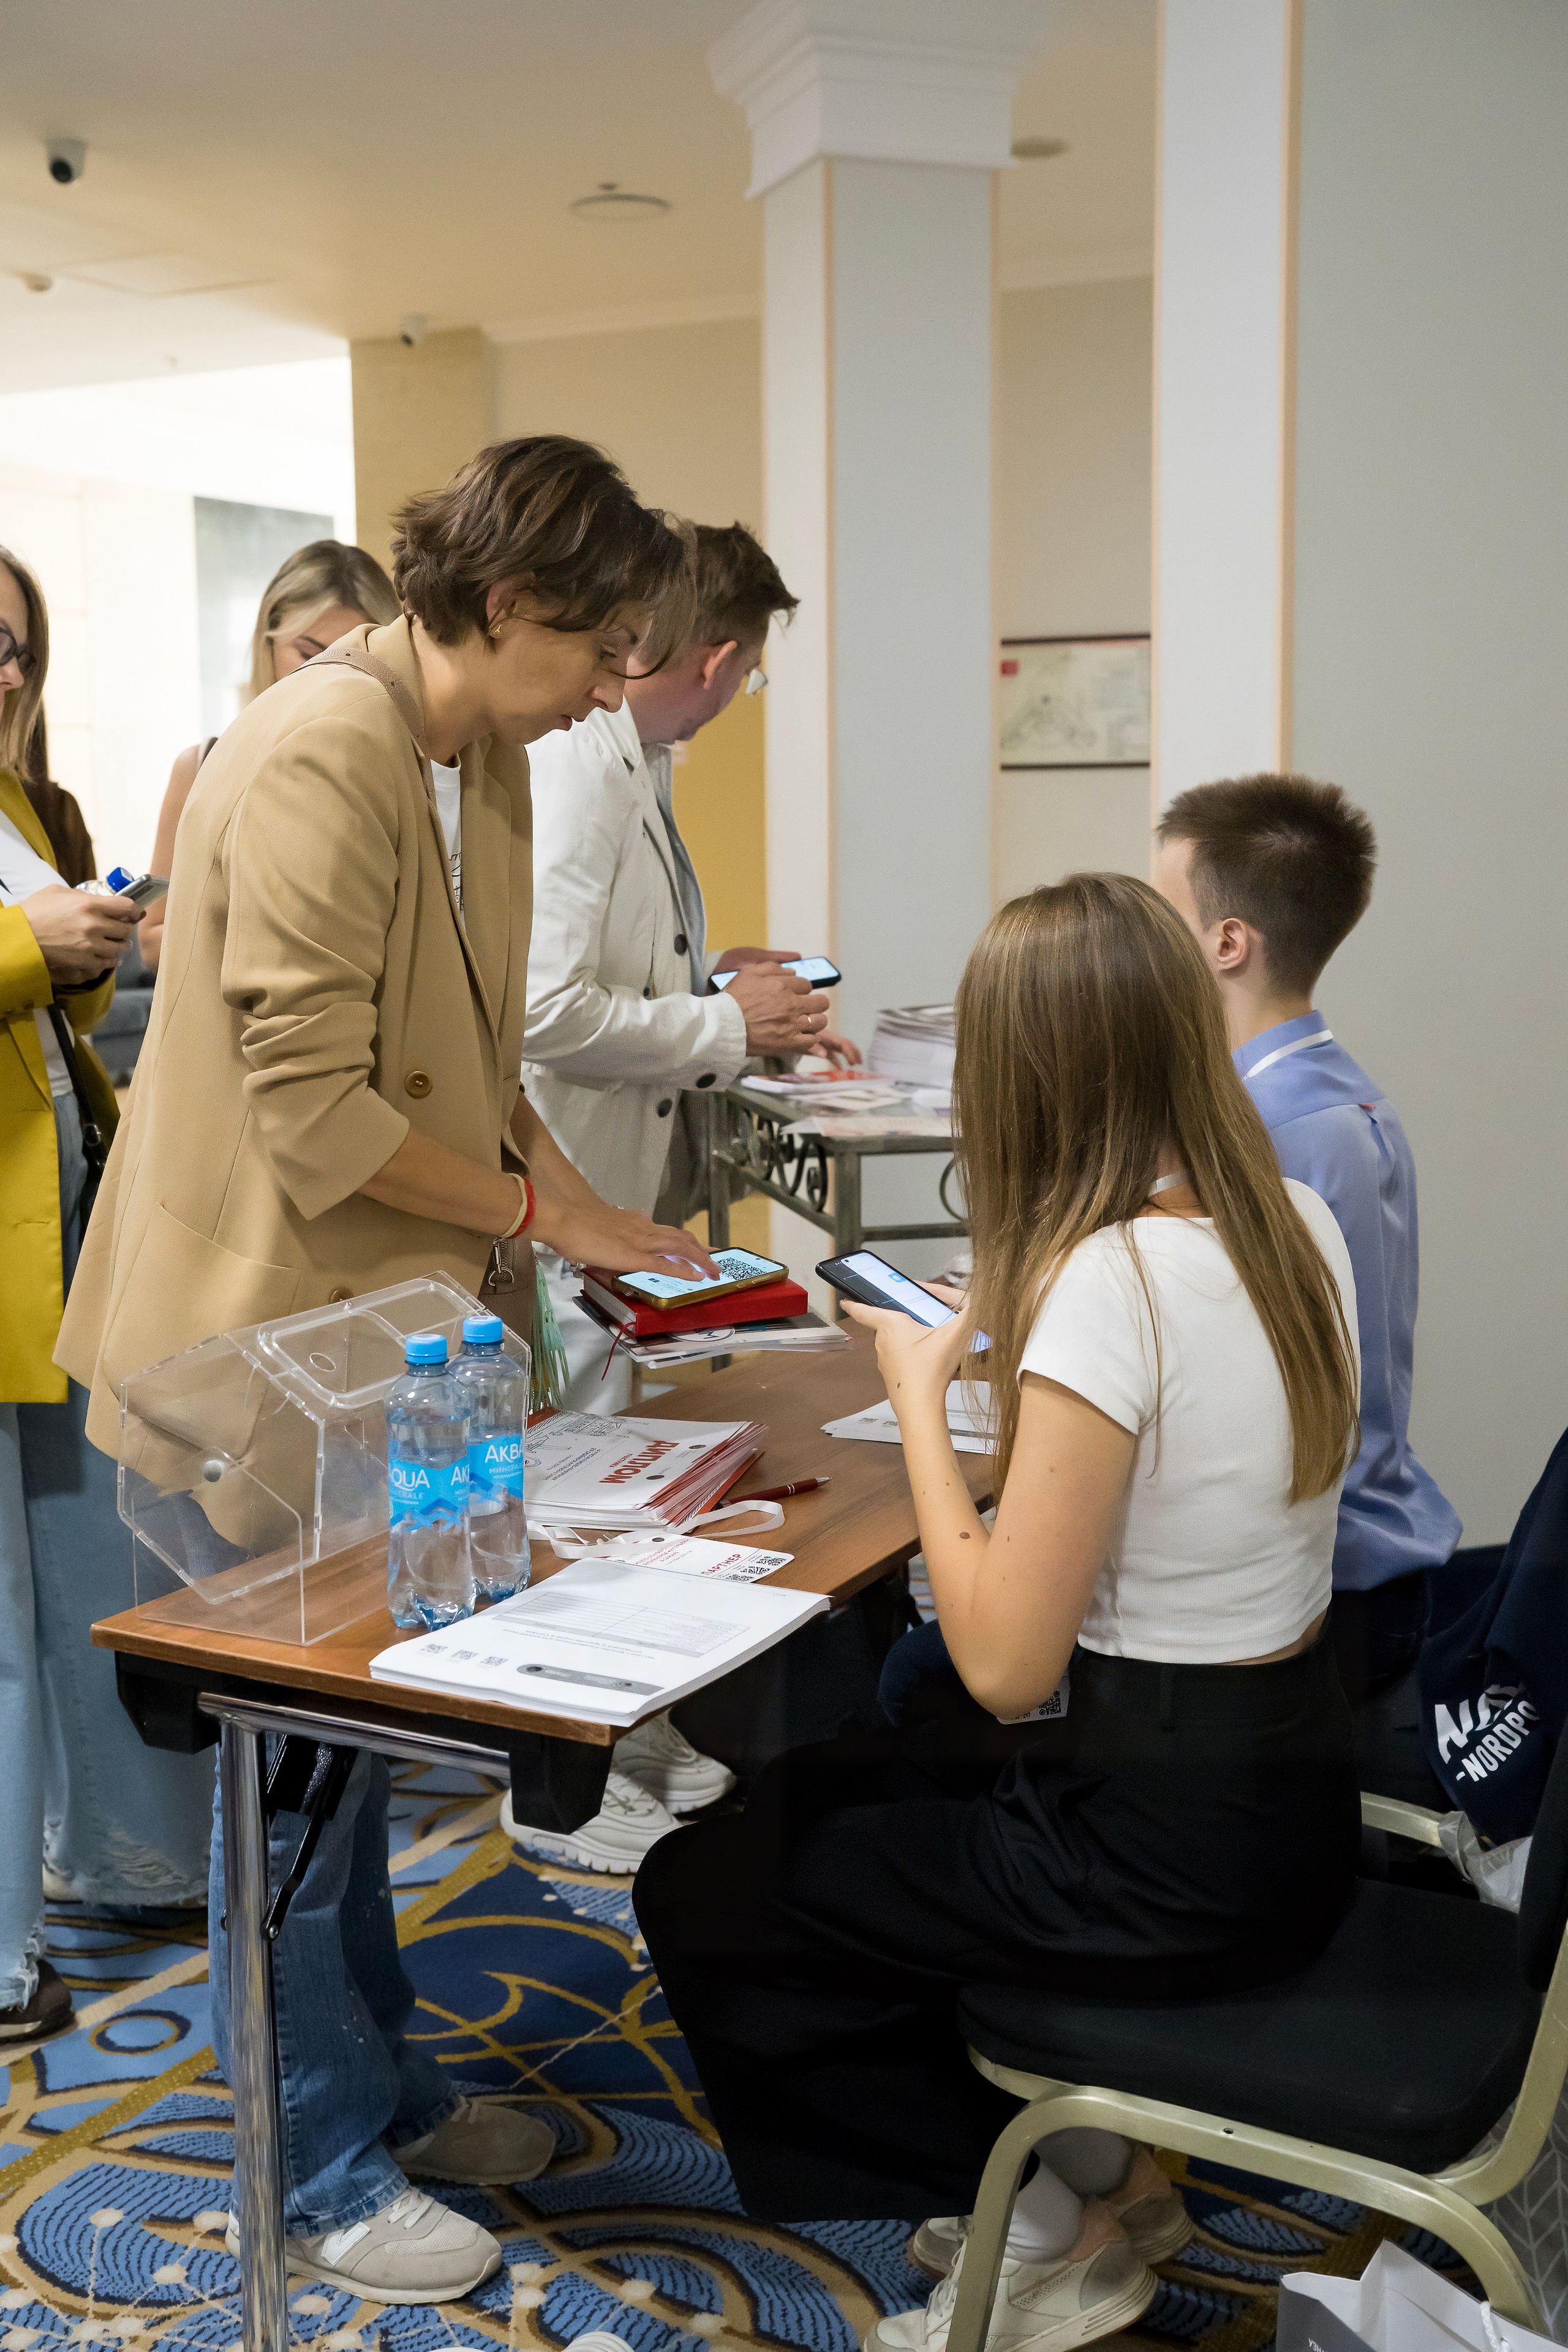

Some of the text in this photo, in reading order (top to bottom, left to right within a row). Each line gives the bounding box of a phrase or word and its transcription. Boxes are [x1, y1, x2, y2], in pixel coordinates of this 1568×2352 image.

[598, 1441, 680, 1483] ДИПЛОМ
[389, 1468, 430, 1491] QUA
[701, 1554, 742, 1576] ПАРТНЕР
[1308, 2338, 1324, 2352] УЗН
